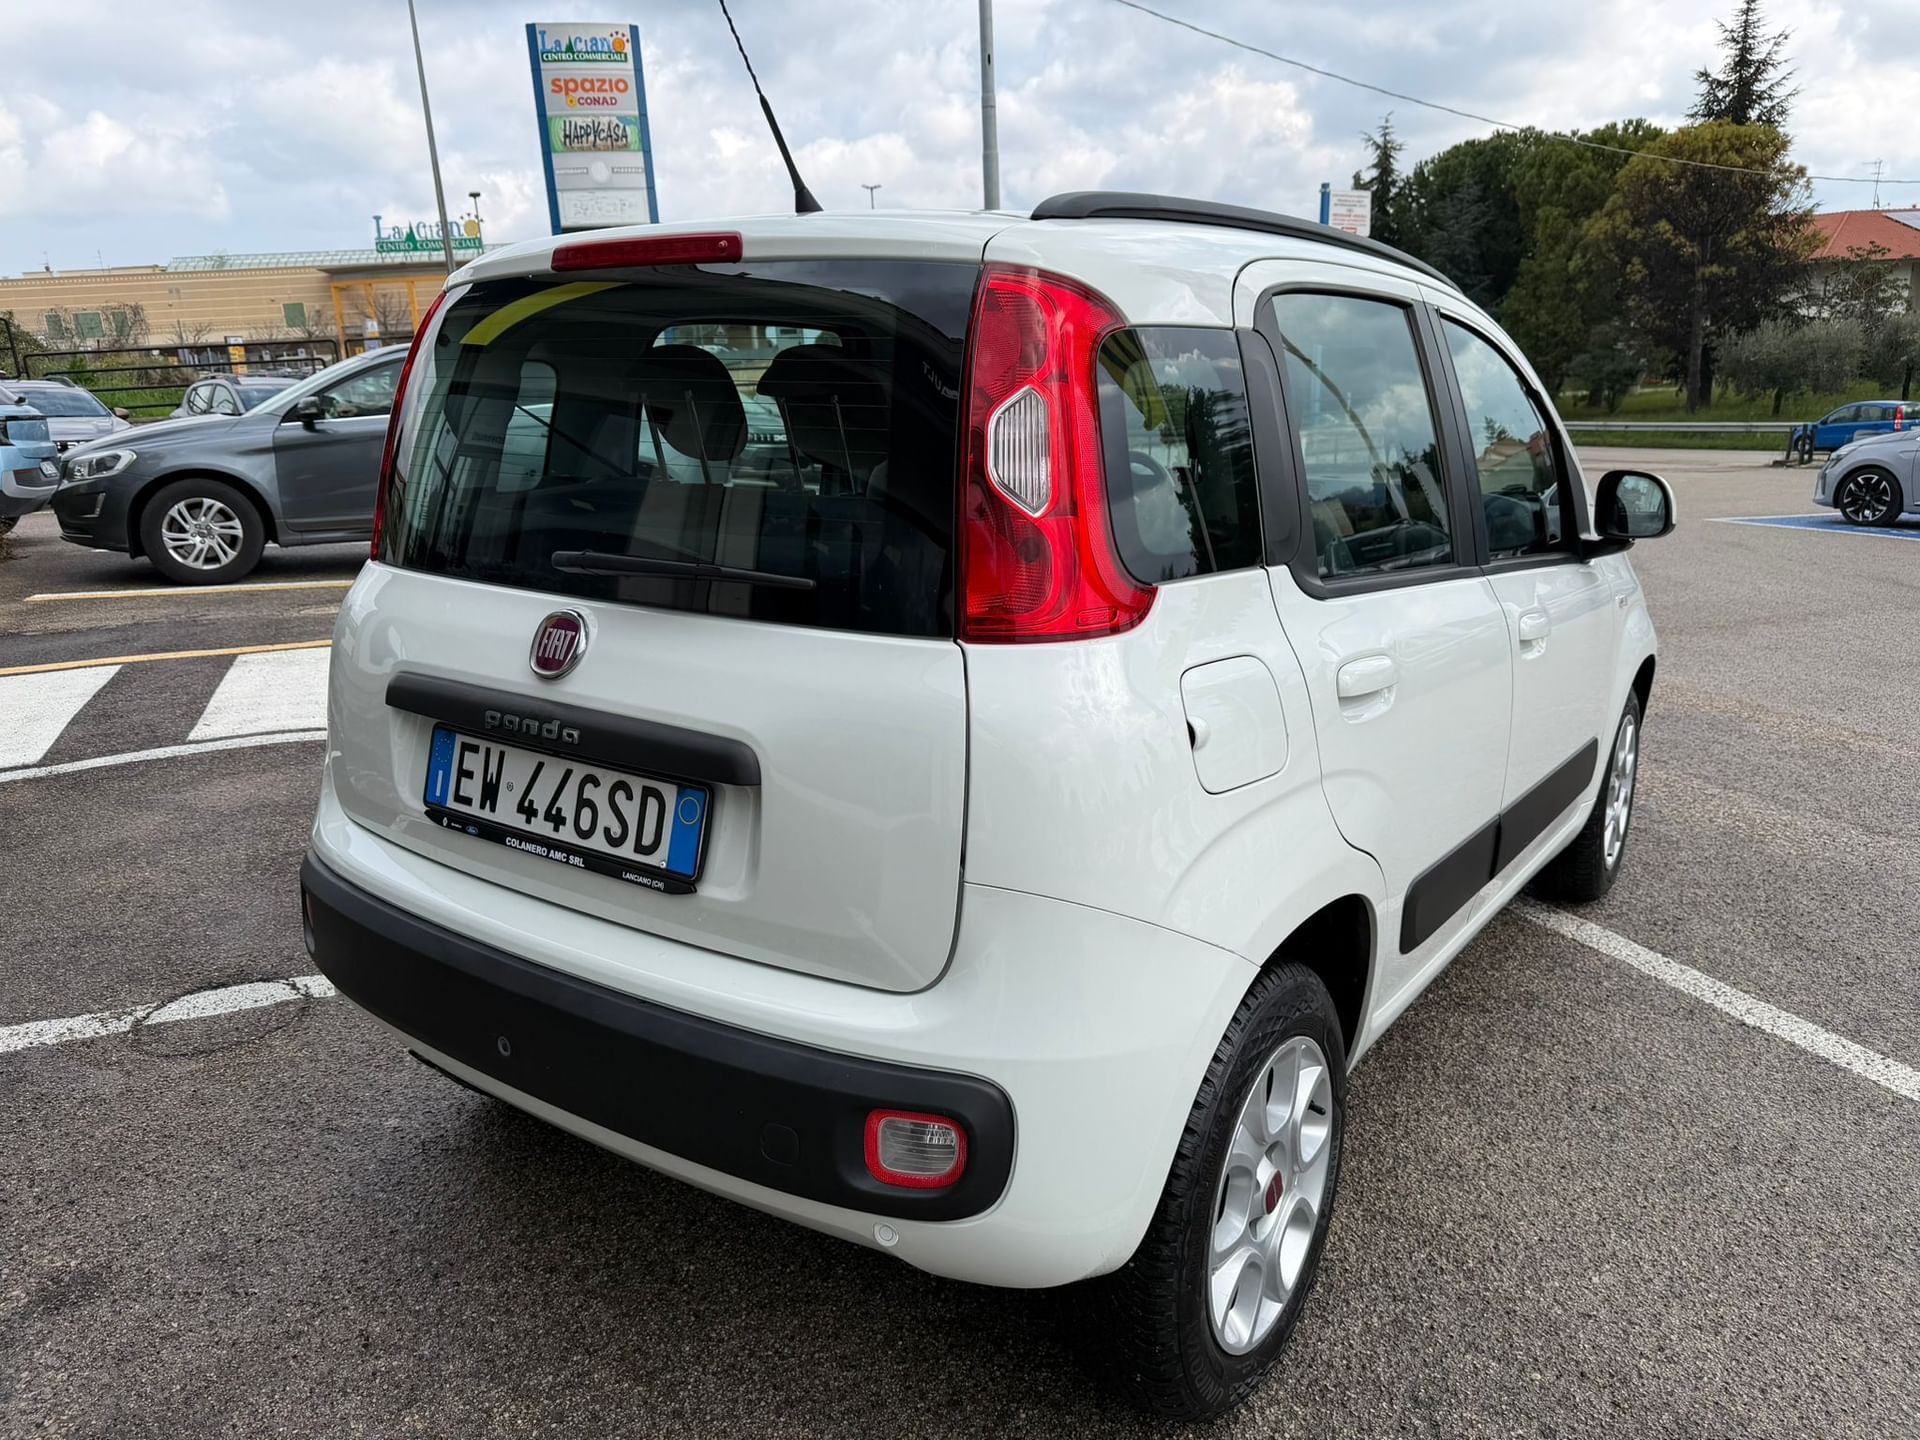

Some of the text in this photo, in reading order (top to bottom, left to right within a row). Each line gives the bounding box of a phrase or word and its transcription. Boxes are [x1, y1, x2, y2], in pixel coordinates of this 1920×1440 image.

[539, 30, 562, 52] La
[542, 52, 626, 61] CENTRO COMMERCIALE
[551, 77, 629, 96] spazio
[577, 96, 617, 106] CONAD
[372, 215, 405, 240] La
[377, 240, 413, 251] CENTRO
[538, 627, 576, 661] FIAT
[484, 710, 581, 745] panda
[505, 836, 585, 868] COLANERO AMC SRL
[622, 871, 652, 886] LANCIANO
